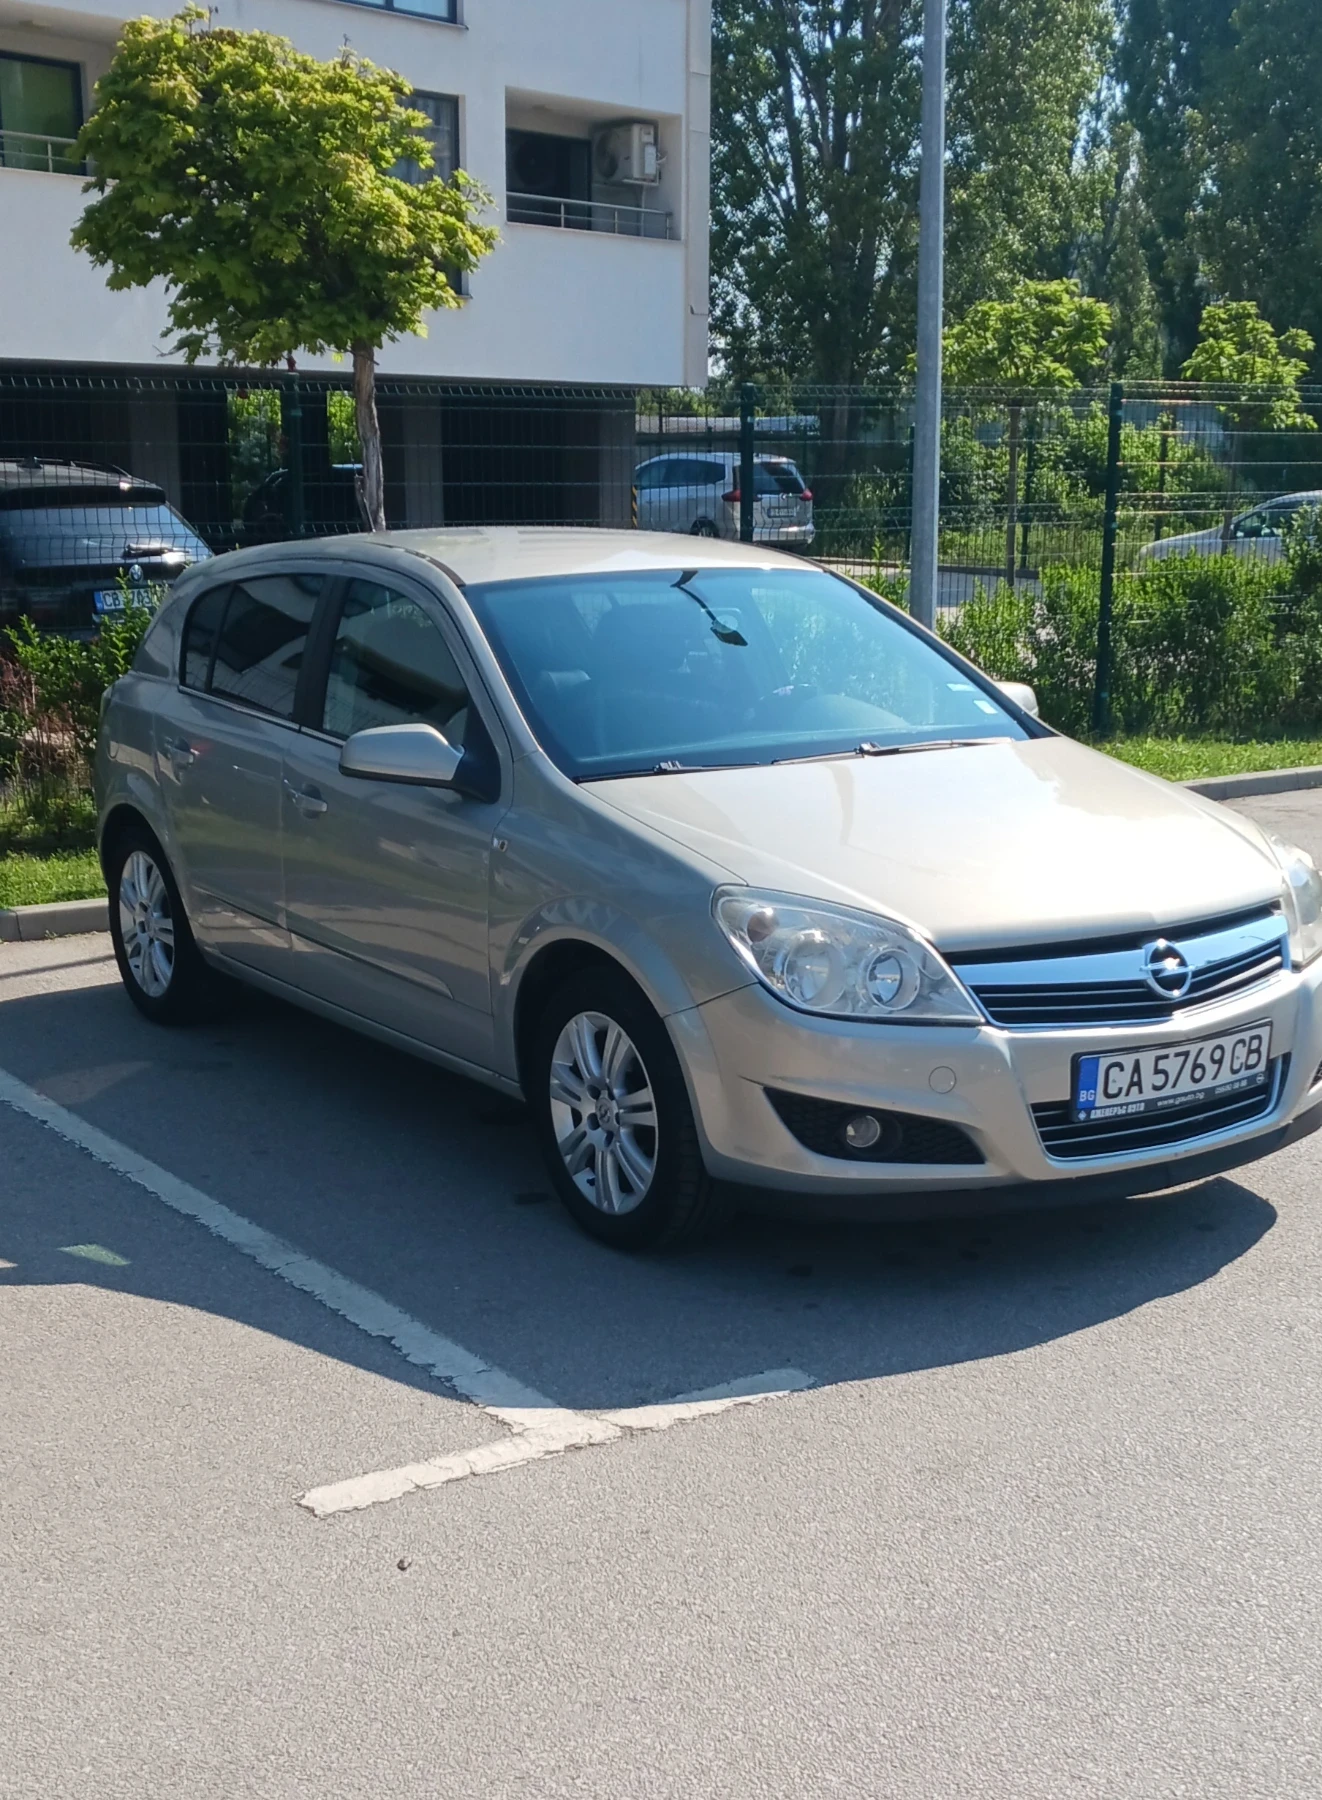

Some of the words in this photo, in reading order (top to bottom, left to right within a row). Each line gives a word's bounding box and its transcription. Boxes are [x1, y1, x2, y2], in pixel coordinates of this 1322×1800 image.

[1103, 1058, 1144, 1100] CA
[1151, 1044, 1226, 1092] 5769
[1229, 1034, 1263, 1075] CB
[1079, 1089, 1096, 1102] BG
